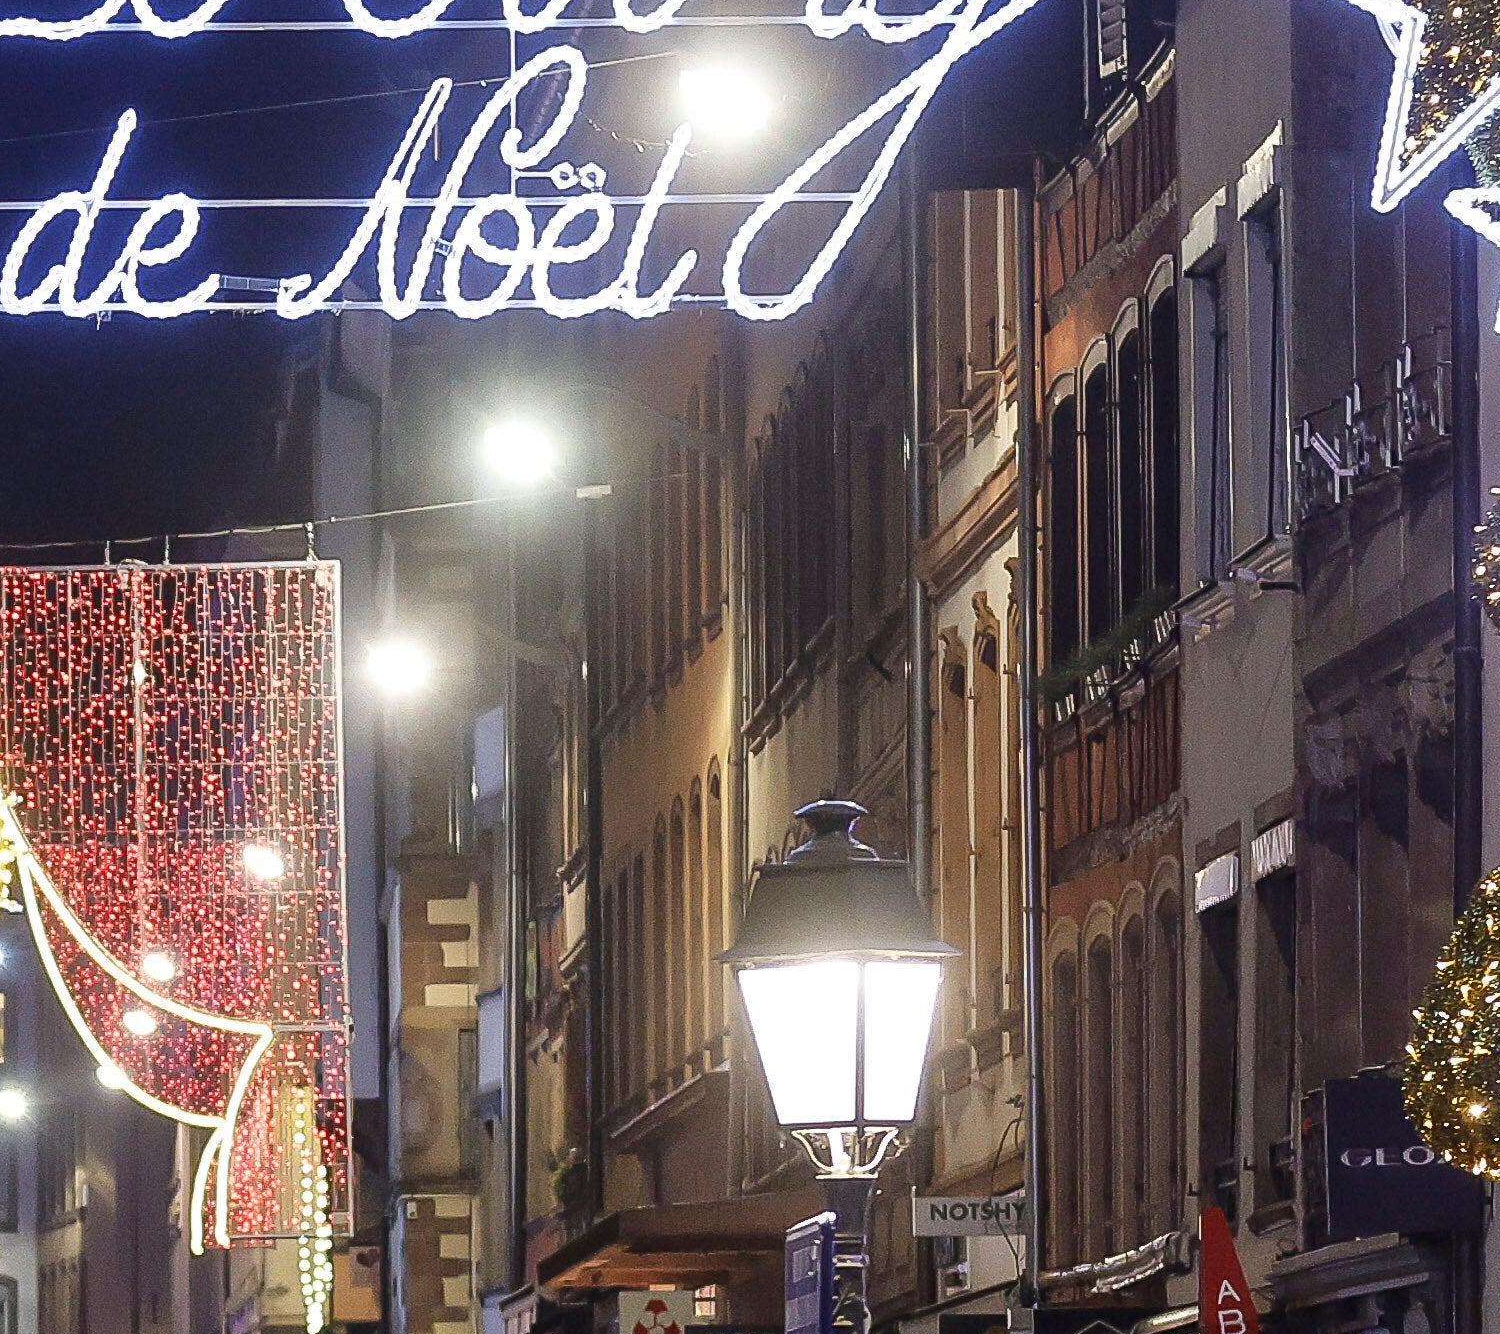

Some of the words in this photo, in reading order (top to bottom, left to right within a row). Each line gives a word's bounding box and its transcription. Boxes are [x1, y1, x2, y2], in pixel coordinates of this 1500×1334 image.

[3, 110, 222, 318] de
[280, 45, 697, 319] Noël
[1340, 1145, 1446, 1167] GLO
[930, 1202, 1026, 1221] NOTSHY
